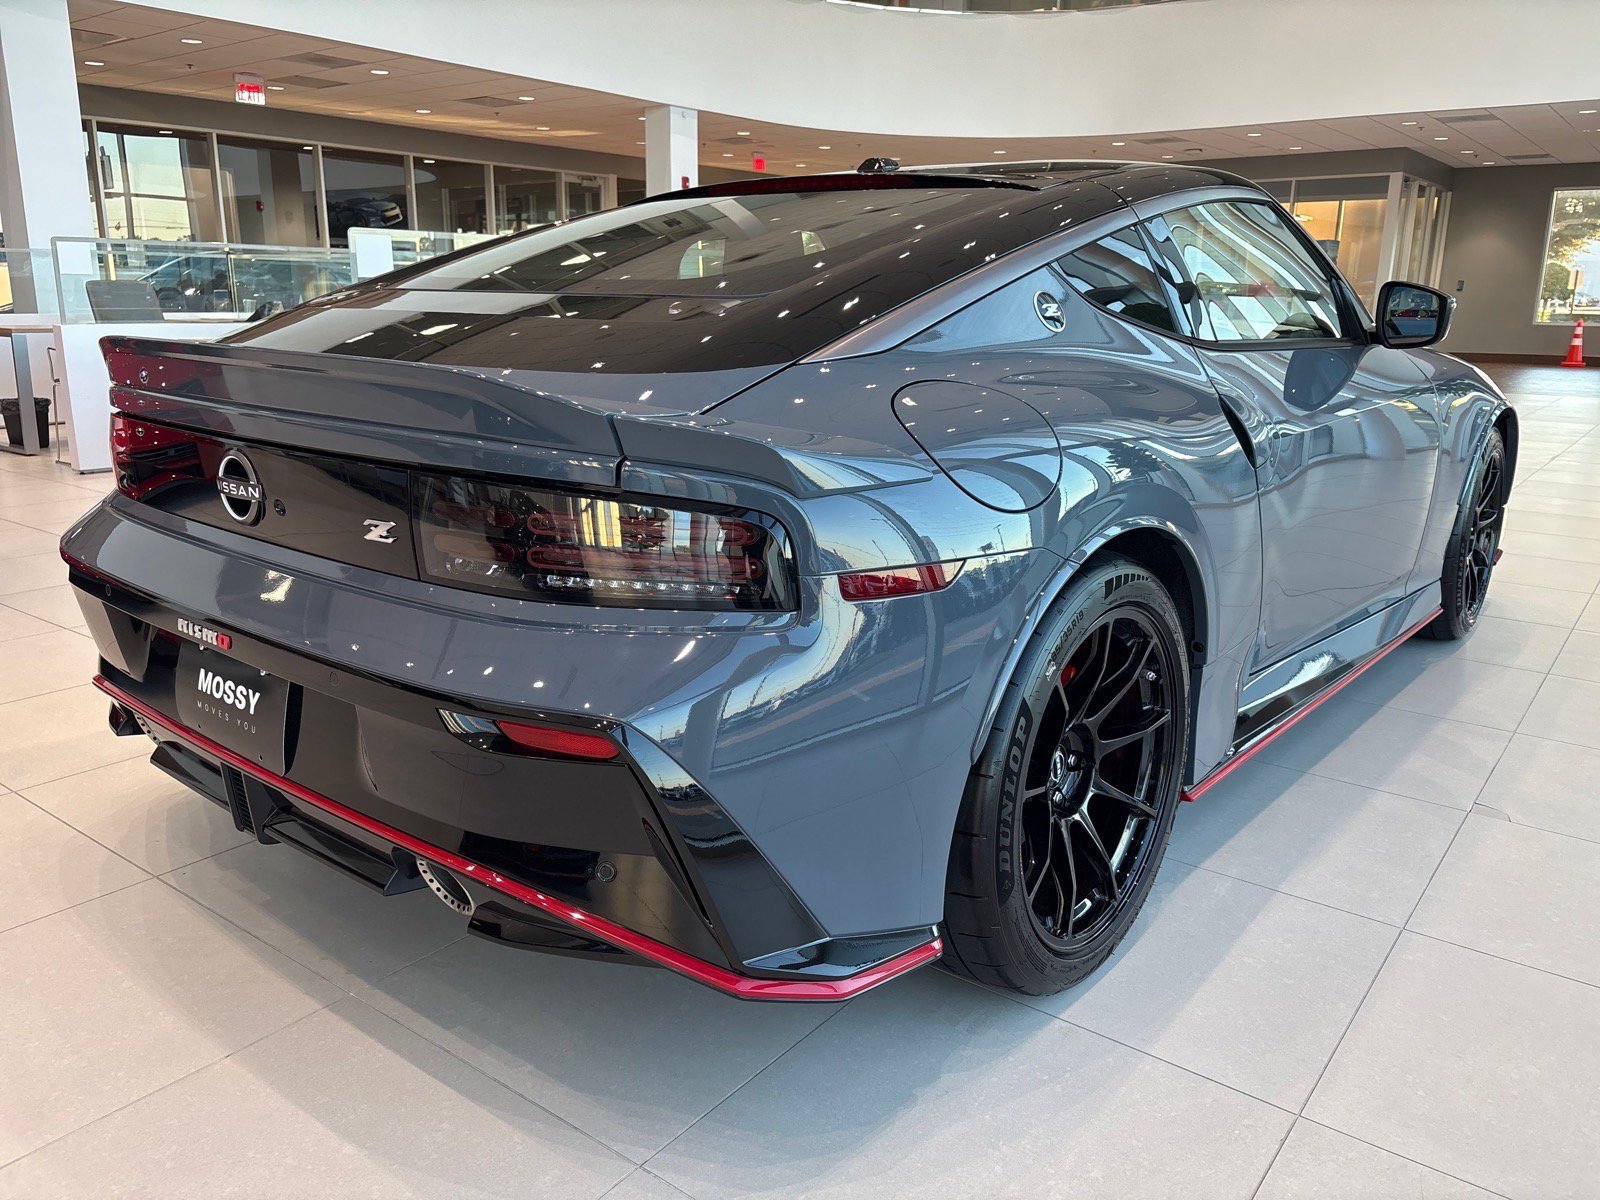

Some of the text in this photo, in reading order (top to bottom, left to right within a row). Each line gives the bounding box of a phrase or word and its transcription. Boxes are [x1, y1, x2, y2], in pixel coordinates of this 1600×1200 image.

[219, 480, 259, 499] ISSAN
[363, 519, 397, 543] Z
[198, 667, 260, 715] MOSSY
[197, 700, 257, 734] MOVES YOU
[1000, 715, 1027, 873] DUNLOP
